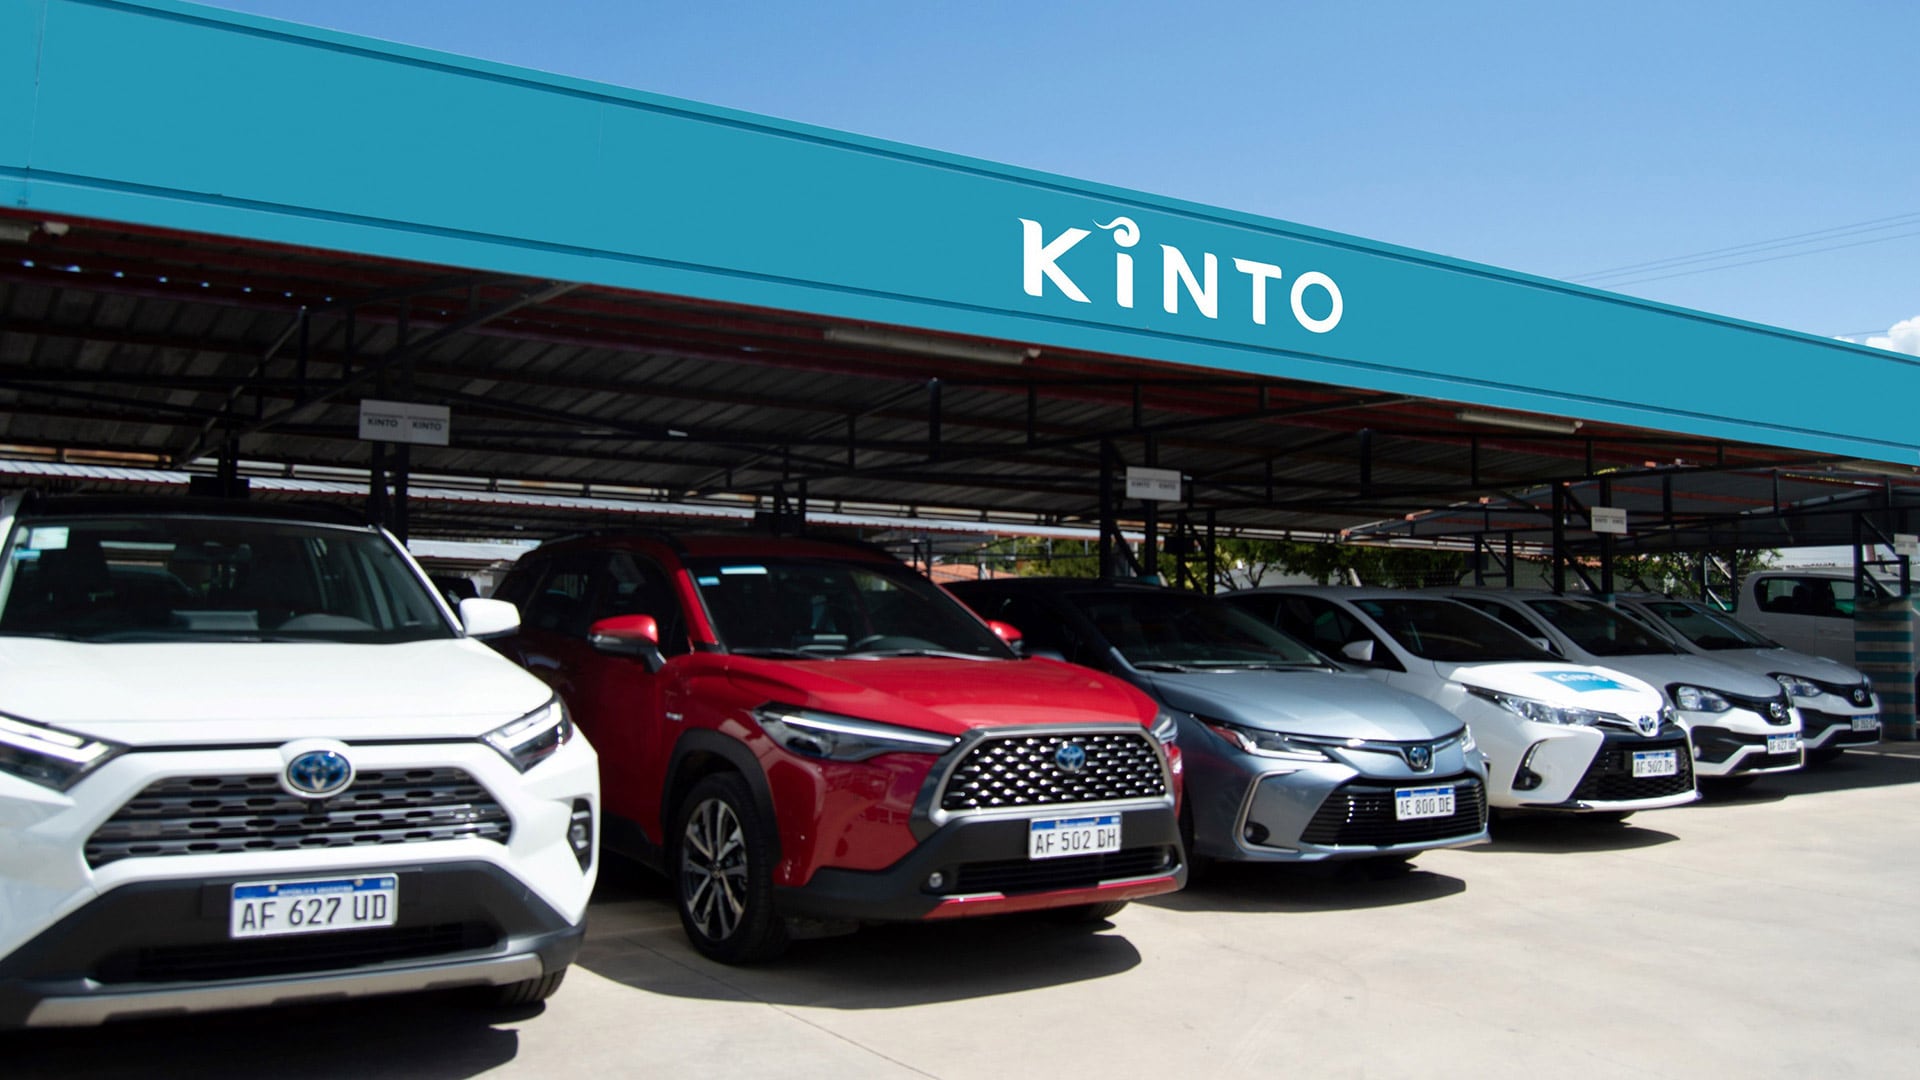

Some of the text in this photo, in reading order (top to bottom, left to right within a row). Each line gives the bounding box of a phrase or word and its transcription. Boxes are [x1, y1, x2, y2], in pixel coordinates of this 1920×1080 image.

[1647, 760, 1662, 774] 502
[1400, 797, 1452, 815] AE 800 DE
[1035, 828, 1116, 854] AF 502 DH
[241, 894, 386, 930] AF 627 UD
